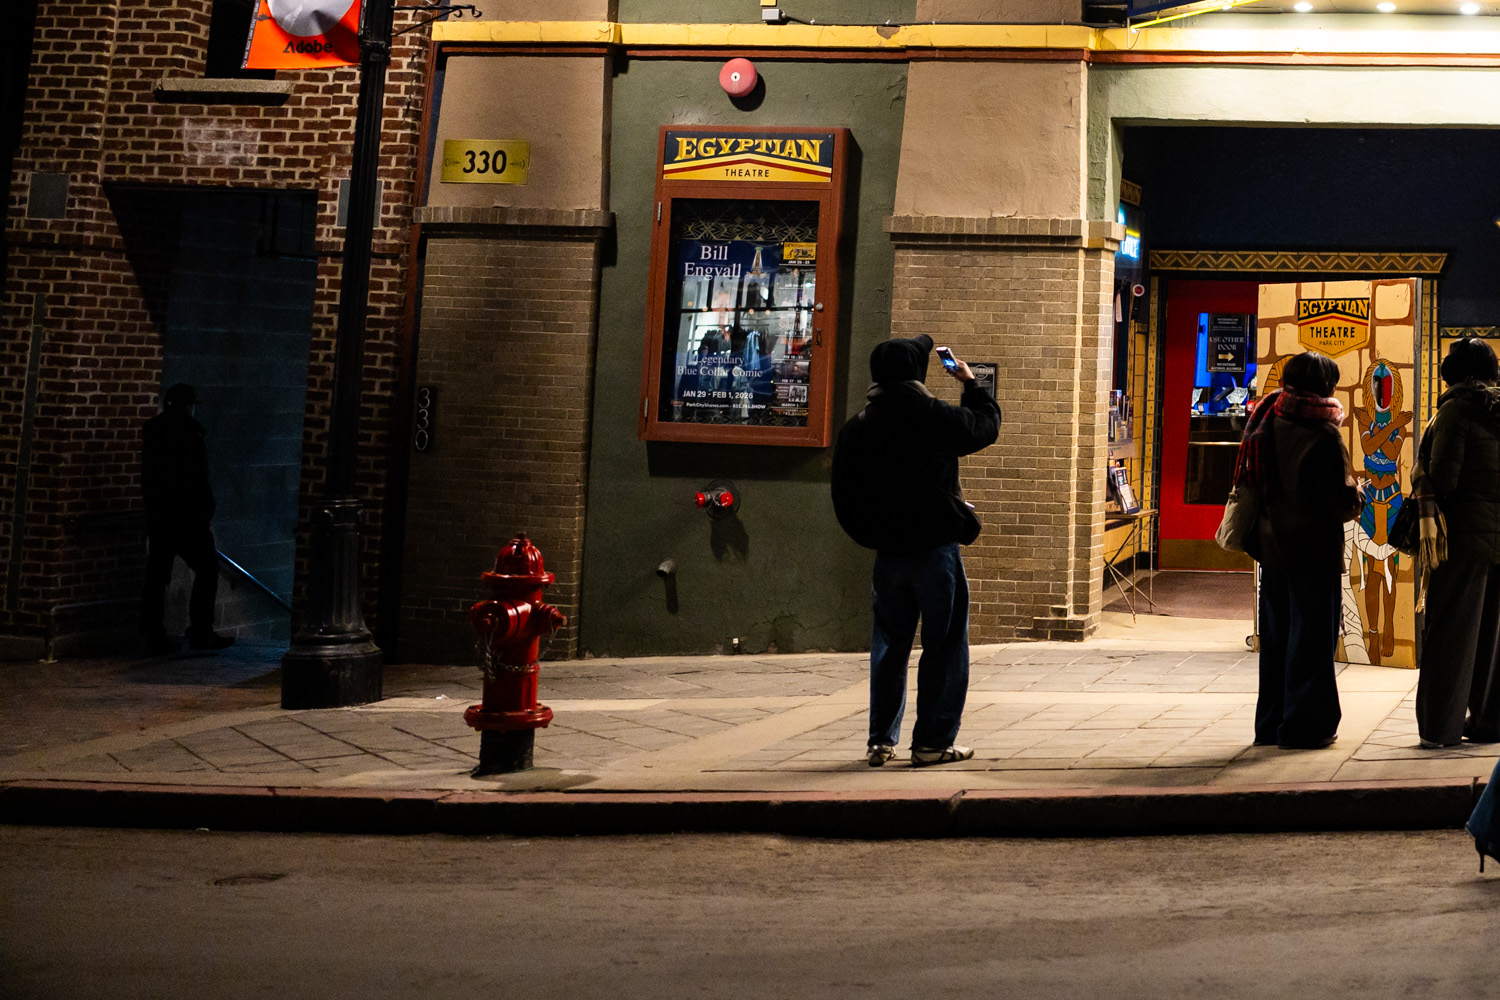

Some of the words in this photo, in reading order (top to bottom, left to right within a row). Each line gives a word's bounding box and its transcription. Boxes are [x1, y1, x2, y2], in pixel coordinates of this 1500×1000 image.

[282, 39, 334, 53] Adobe
[673, 137, 824, 163] EGYPTIAN
[462, 149, 507, 174] 330
[725, 168, 770, 178] THEATRE
[699, 245, 728, 260] Bill
[684, 262, 742, 280] Engvall
[1299, 299, 1369, 318] EGYPTIAN
[1310, 327, 1355, 338] THEATRE
[677, 365, 698, 376] Blue
[700, 366, 729, 377] Collar
[732, 366, 763, 378] Comic
[415, 387, 430, 451] 330
